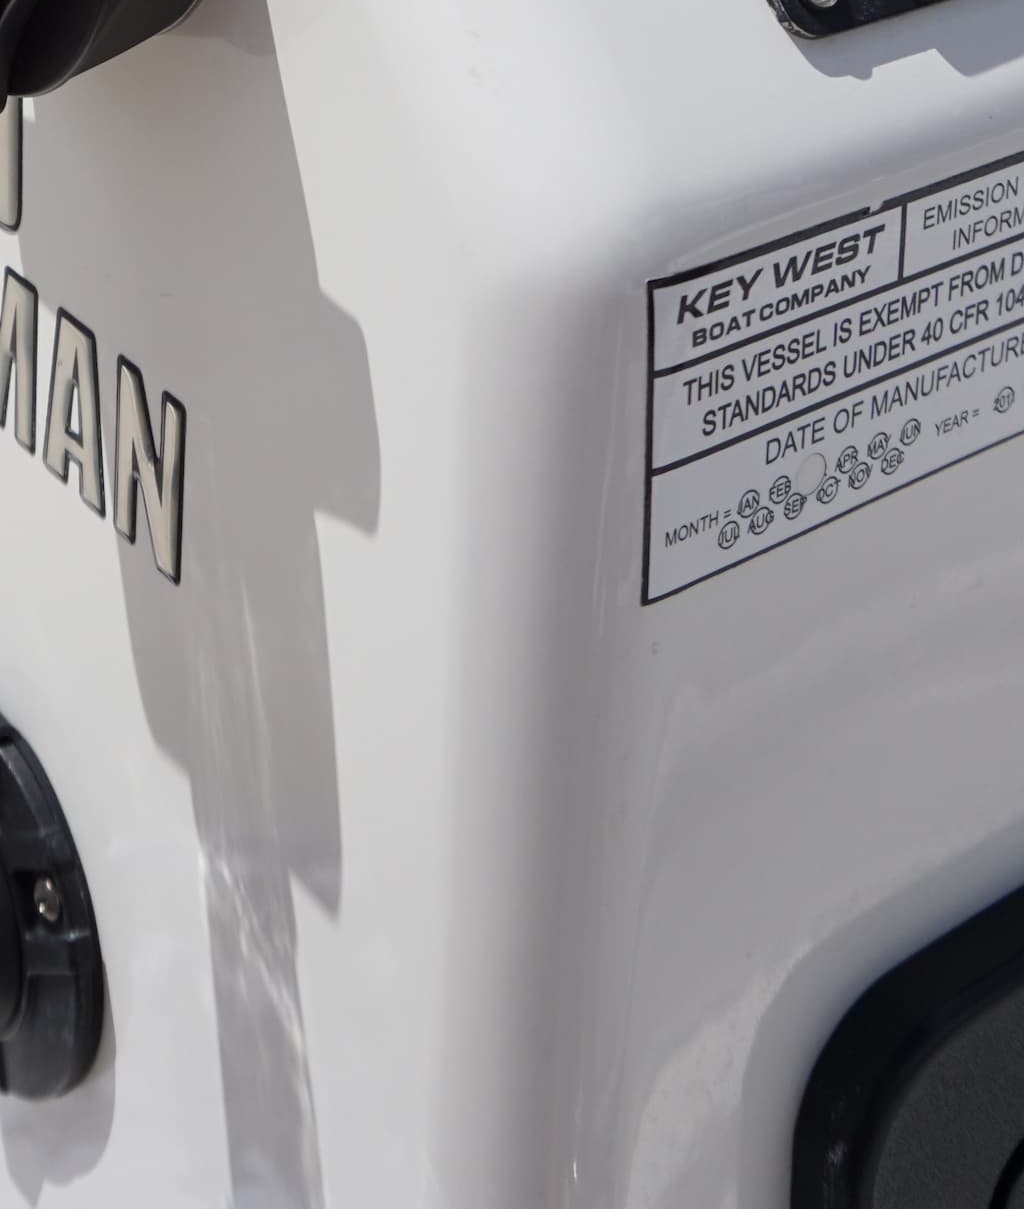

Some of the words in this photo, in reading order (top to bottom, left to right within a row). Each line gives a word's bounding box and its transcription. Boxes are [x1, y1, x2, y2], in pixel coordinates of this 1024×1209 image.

[923, 176, 1019, 230] EMISSION
[676, 268, 764, 324] KEY
[774, 224, 886, 288] WEST
[692, 309, 755, 348] BOAT
[759, 266, 871, 321] COMPANY
[683, 365, 735, 406] THIS
[742, 329, 827, 382] VESSEL
[833, 318, 852, 346] IS
[859, 281, 944, 336] EXEMPT
[948, 257, 1005, 301] FROM
[702, 361, 836, 437] STANDARDS
[843, 328, 916, 378] UNDER
[921, 317, 944, 345] 40
[949, 299, 989, 335] CFR
[665, 510, 719, 548] MONTH
[738, 492, 760, 516] JAN
[769, 478, 791, 502] FEB
[835, 448, 858, 472] APR
[867, 434, 891, 458] MAY
[900, 421, 921, 444] JUN
[934, 410, 968, 436] YEAR
[765, 423, 827, 465] DATE
[833, 400, 864, 434] OF
[719, 526, 739, 547] JUL
[748, 510, 774, 534] AUG
[784, 495, 807, 517] SEP
[848, 464, 873, 488] NOV
[881, 451, 904, 474] DEC
